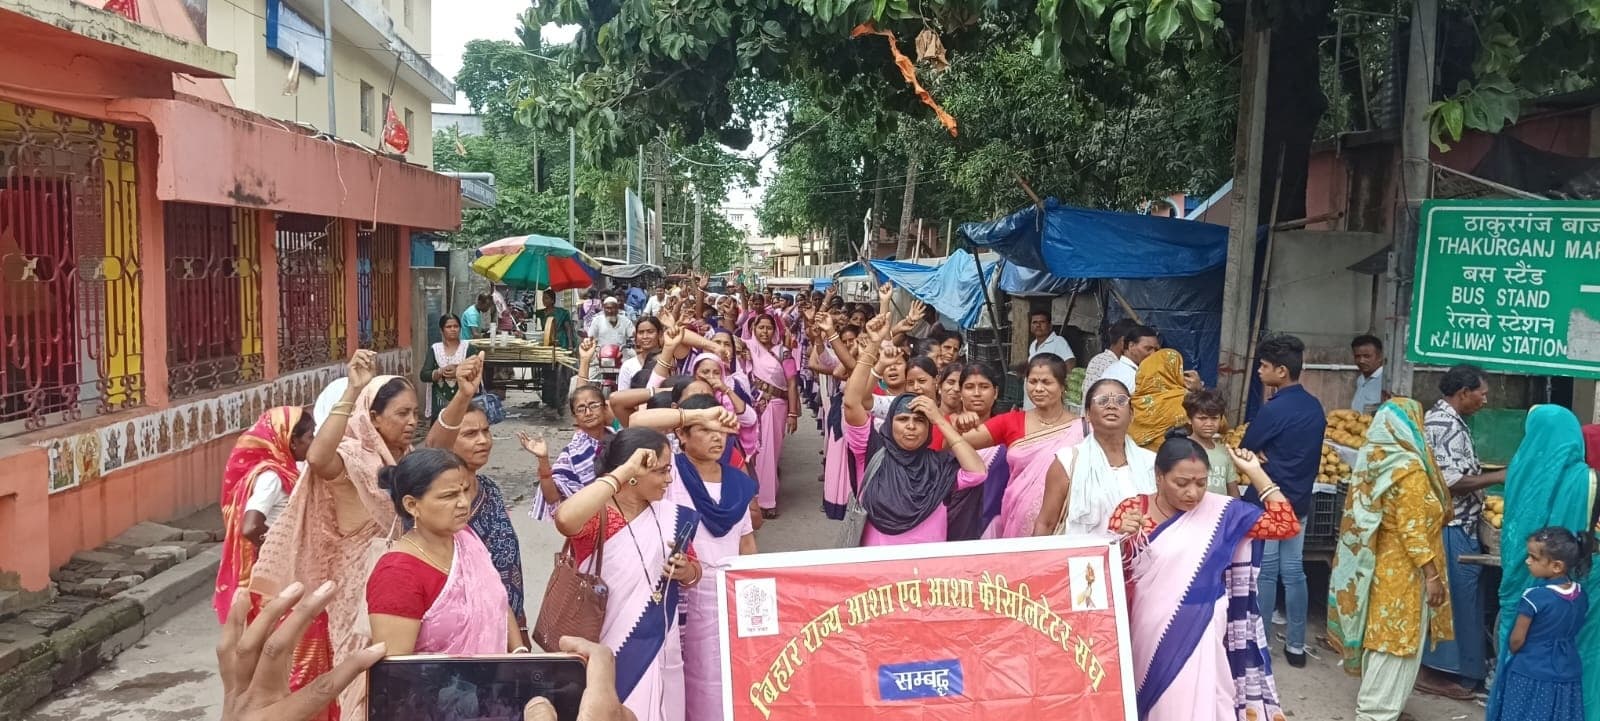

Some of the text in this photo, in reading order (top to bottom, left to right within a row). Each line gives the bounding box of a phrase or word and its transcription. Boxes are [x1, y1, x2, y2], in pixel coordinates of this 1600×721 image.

[1463, 213, 1553, 237] ठाकुरगंज
[1438, 236, 1555, 258] THAKURGANJ
[1462, 260, 1546, 286] बस स्टैंड
[1452, 286, 1551, 309] BUS STAND
[1446, 306, 1555, 334] रेलवे स्टेशन
[1430, 330, 1568, 358] RAILWAY STATION
[749, 567, 1106, 720] बिहार राज्य आशा एवं आशा फैसिलिटेटर संघ
